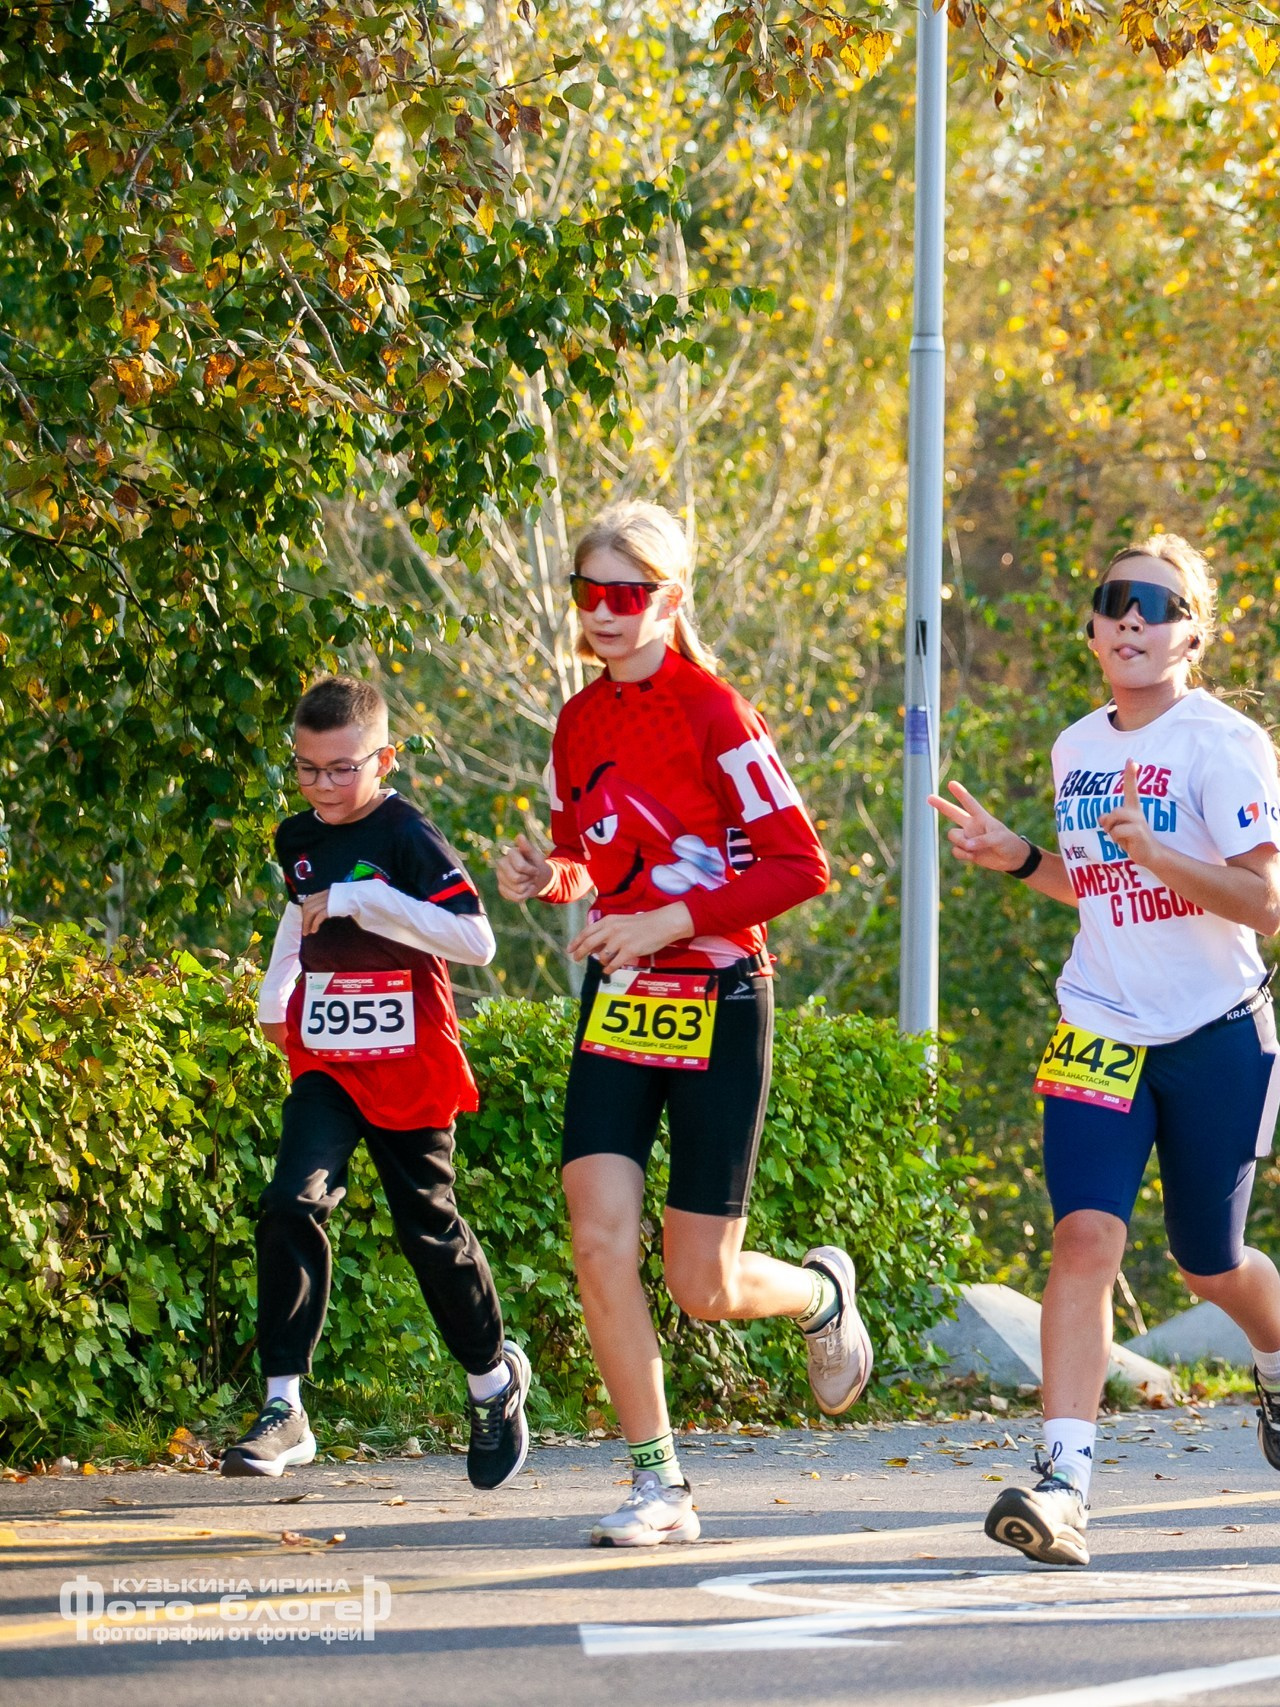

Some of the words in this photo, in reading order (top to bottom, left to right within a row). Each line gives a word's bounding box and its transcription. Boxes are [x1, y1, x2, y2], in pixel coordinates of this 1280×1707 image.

[1110, 893, 1123, 928] С
[307, 998, 405, 1035] 5953
[601, 1000, 703, 1042] 5163
[1066, 1071, 1111, 1087] АНАСТАСИЯ
